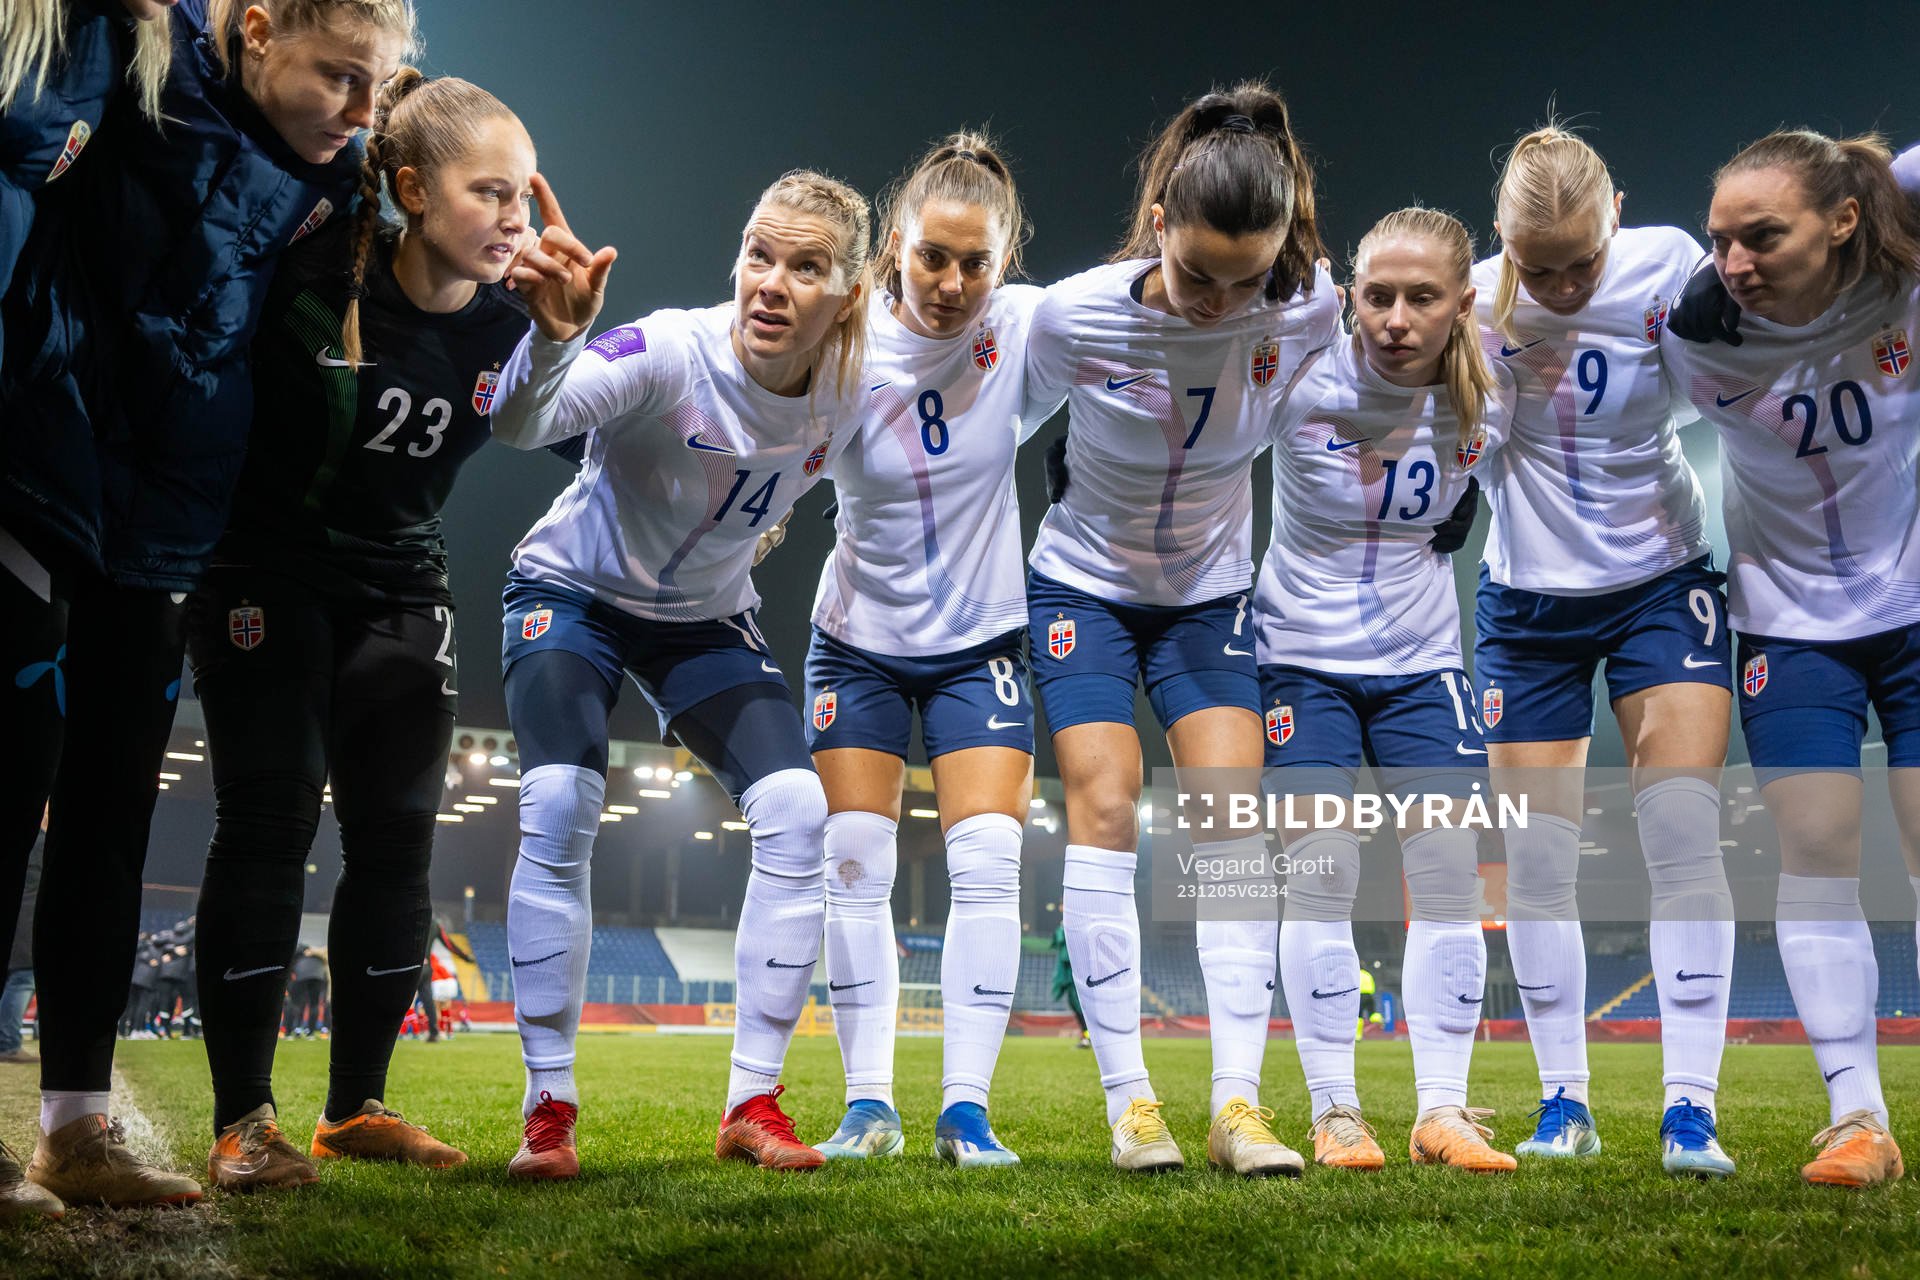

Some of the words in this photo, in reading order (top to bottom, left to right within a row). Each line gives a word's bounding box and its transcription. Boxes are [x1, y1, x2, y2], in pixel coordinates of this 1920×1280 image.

[1577, 349, 1609, 416] 9
[362, 387, 453, 458] 23
[917, 389, 951, 456] 8
[1183, 386, 1217, 450] 7
[1782, 379, 1873, 459] 20
[712, 468, 782, 528] 14
[1377, 460, 1435, 521] 13
[1688, 588, 1717, 646] 9
[987, 656, 1020, 707] 8
